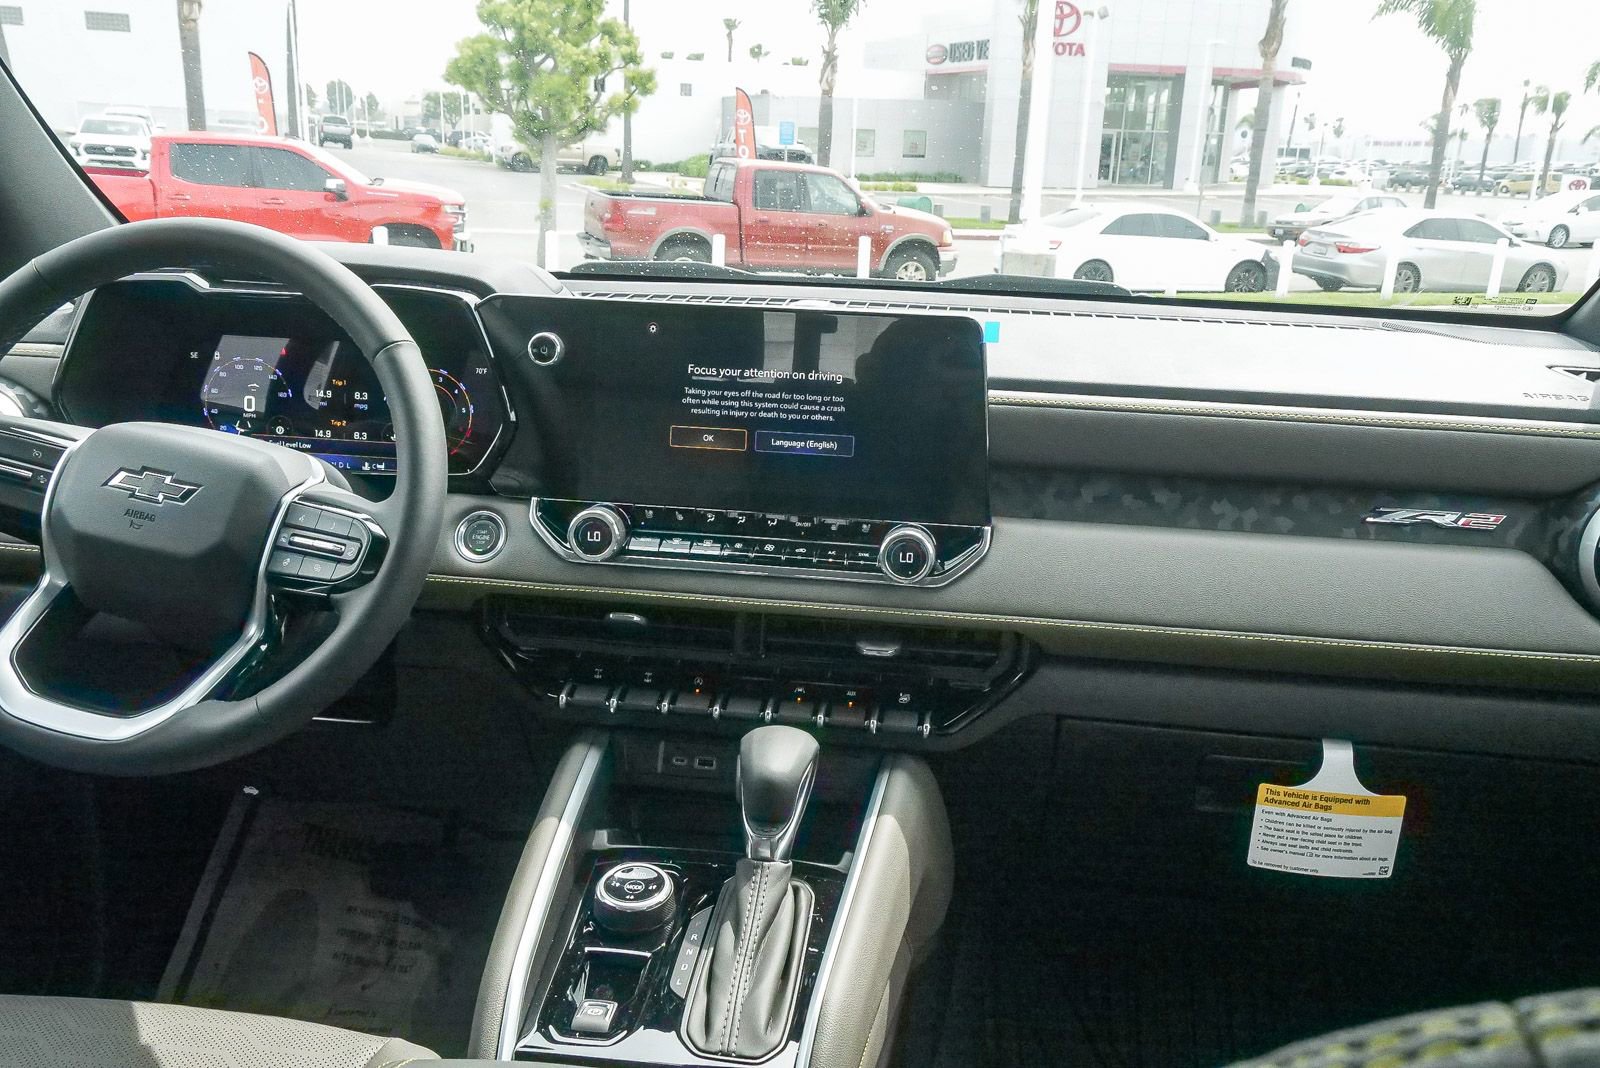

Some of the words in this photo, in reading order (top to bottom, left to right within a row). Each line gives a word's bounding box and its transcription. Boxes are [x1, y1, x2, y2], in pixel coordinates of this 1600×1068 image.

[949, 41, 974, 62] USED
[687, 363, 717, 375] Focus
[718, 368, 742, 378] your
[743, 368, 790, 379] attention
[792, 371, 806, 380] on
[808, 370, 843, 384] driving
[315, 390, 332, 398] 14.9
[354, 391, 368, 400] 8.3
[684, 387, 706, 396] Taking
[723, 390, 740, 398] eyes
[740, 389, 752, 397] off
[806, 393, 822, 403] long
[681, 396, 701, 404] often
[720, 399, 739, 407] using
[754, 401, 778, 409] system
[780, 402, 799, 410] could
[690, 407, 720, 416] resulting
[729, 409, 749, 418] injury
[331, 419, 341, 427] Trip
[314, 429, 332, 438] 14.9
[353, 431, 368, 440] 8.3
[702, 434, 715, 442] OK
[282, 440, 298, 449] Level
[771, 438, 805, 449] Language
[806, 440, 838, 450] (English)
[124, 508, 156, 522] AIRBAG
[1266, 788, 1280, 796] This
[1283, 791, 1309, 800] Vehicle
[1320, 795, 1353, 804] Equipped
[1264, 796, 1299, 807] Advanced
[1314, 802, 1332, 811] Bags
